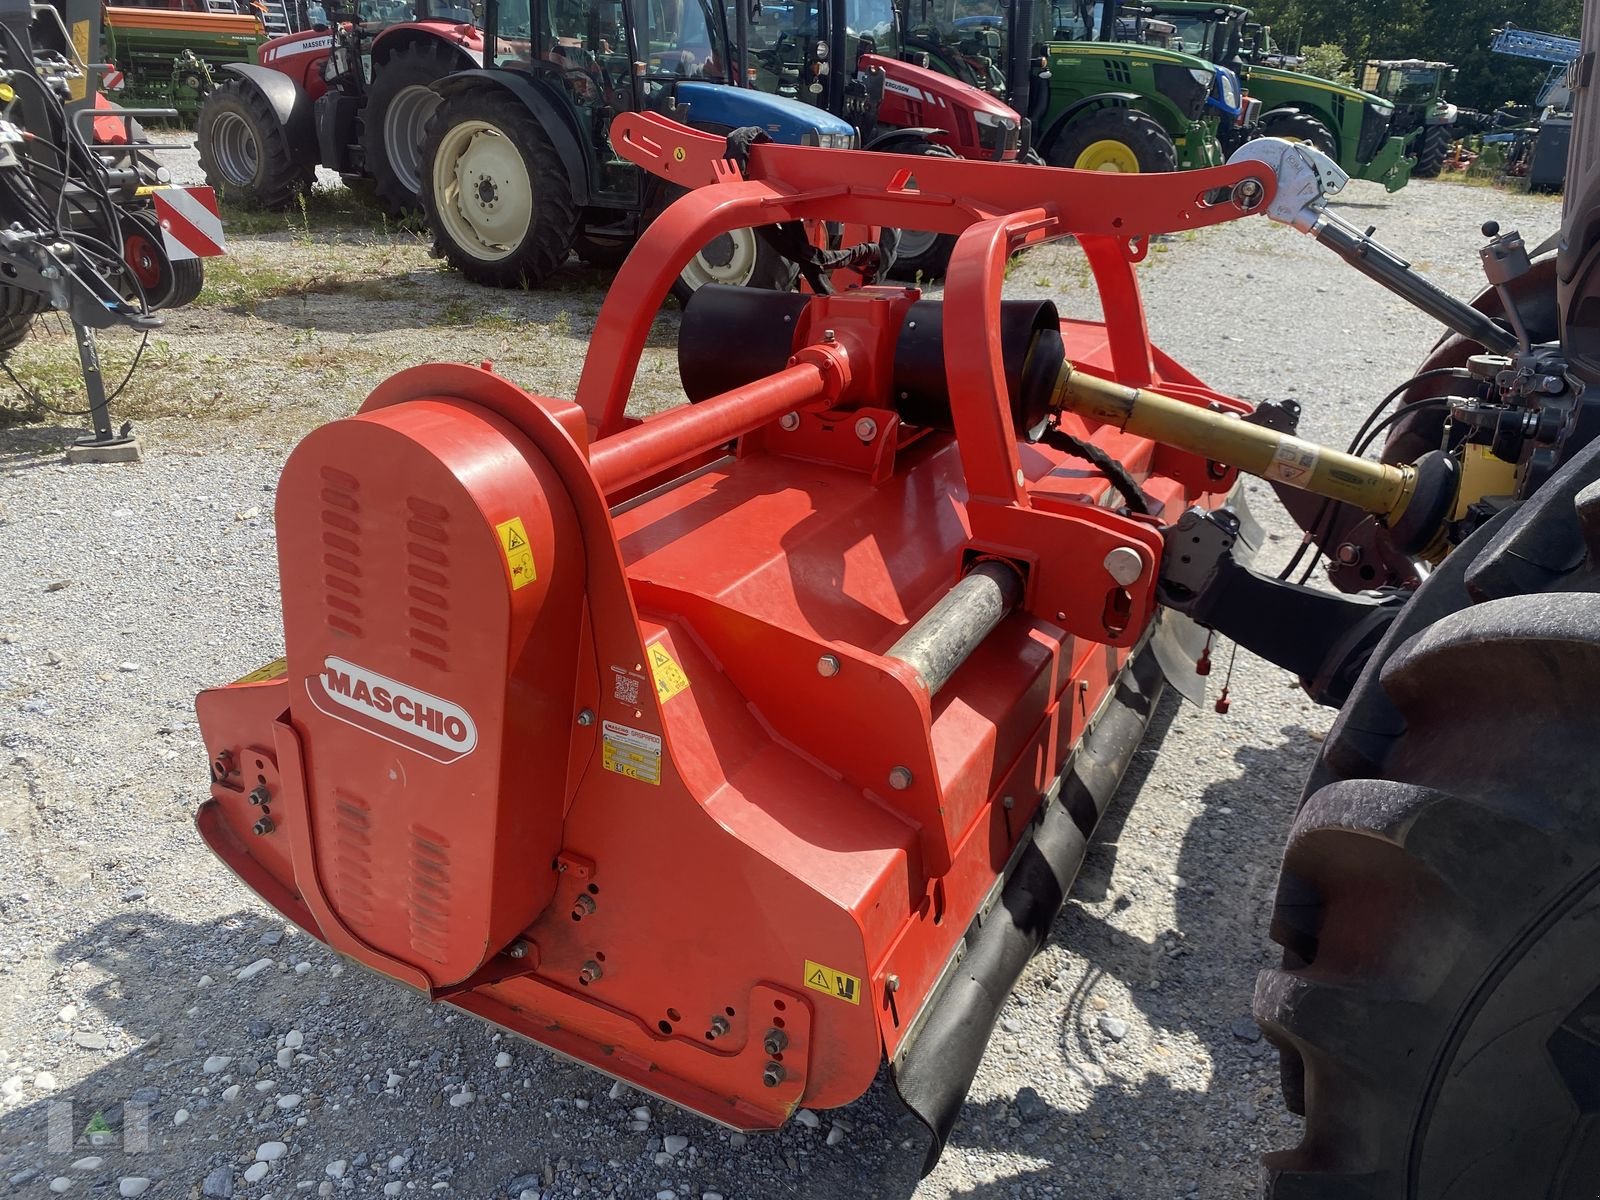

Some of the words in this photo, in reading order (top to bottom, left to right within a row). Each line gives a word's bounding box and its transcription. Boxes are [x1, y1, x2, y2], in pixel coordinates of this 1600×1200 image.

[302, 39, 326, 49] MASSEY
[886, 81, 910, 93] ERGUSON
[326, 666, 468, 743] MASCHIO
